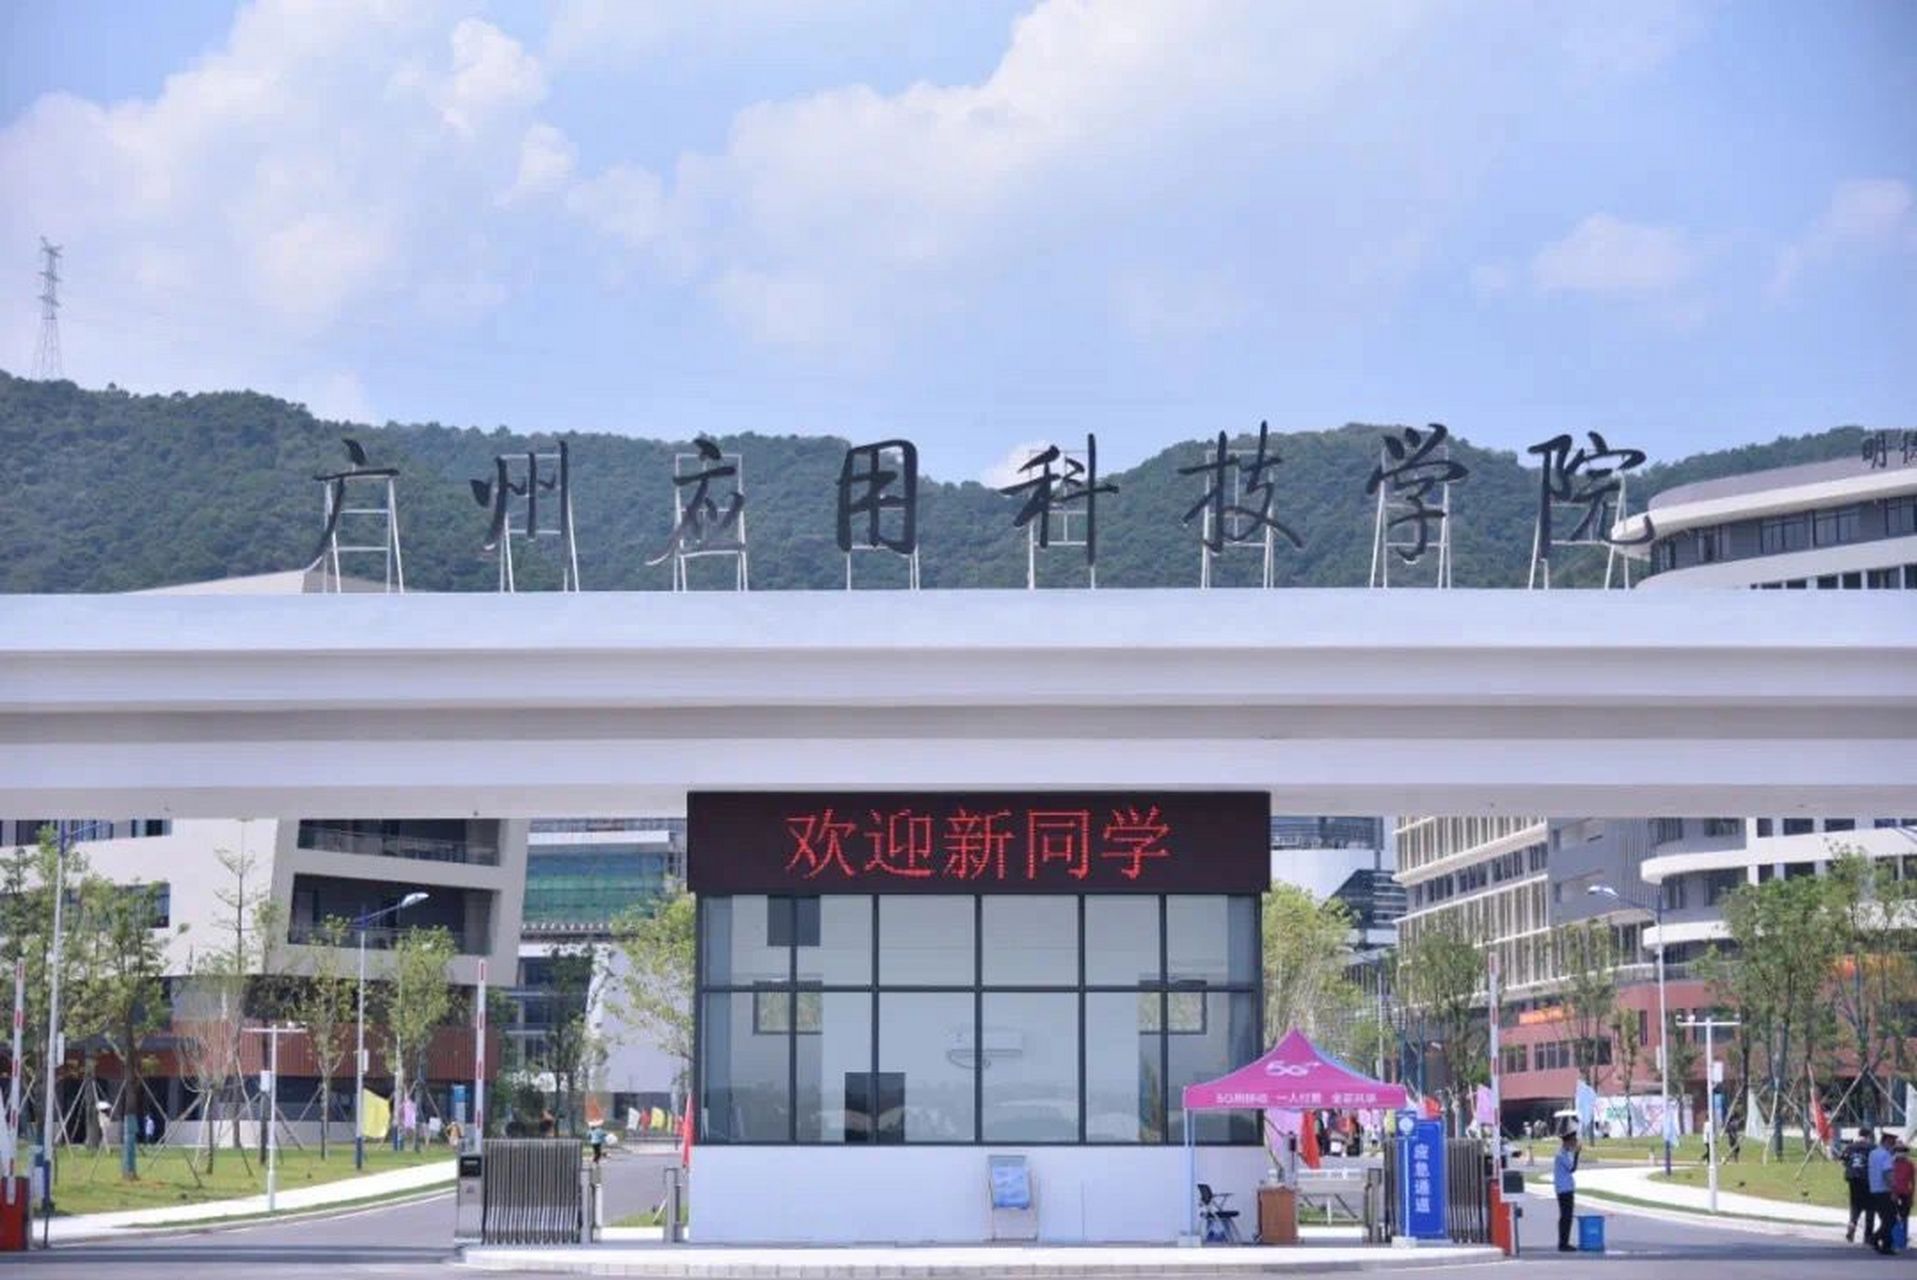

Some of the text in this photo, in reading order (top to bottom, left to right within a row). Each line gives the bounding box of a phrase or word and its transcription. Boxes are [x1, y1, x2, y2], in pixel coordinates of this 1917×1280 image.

[303, 421, 1655, 572] 广州应用科技学院
[784, 807, 1171, 880] 欢迎新同学
[1413, 1143, 1430, 1213] 应急通道
